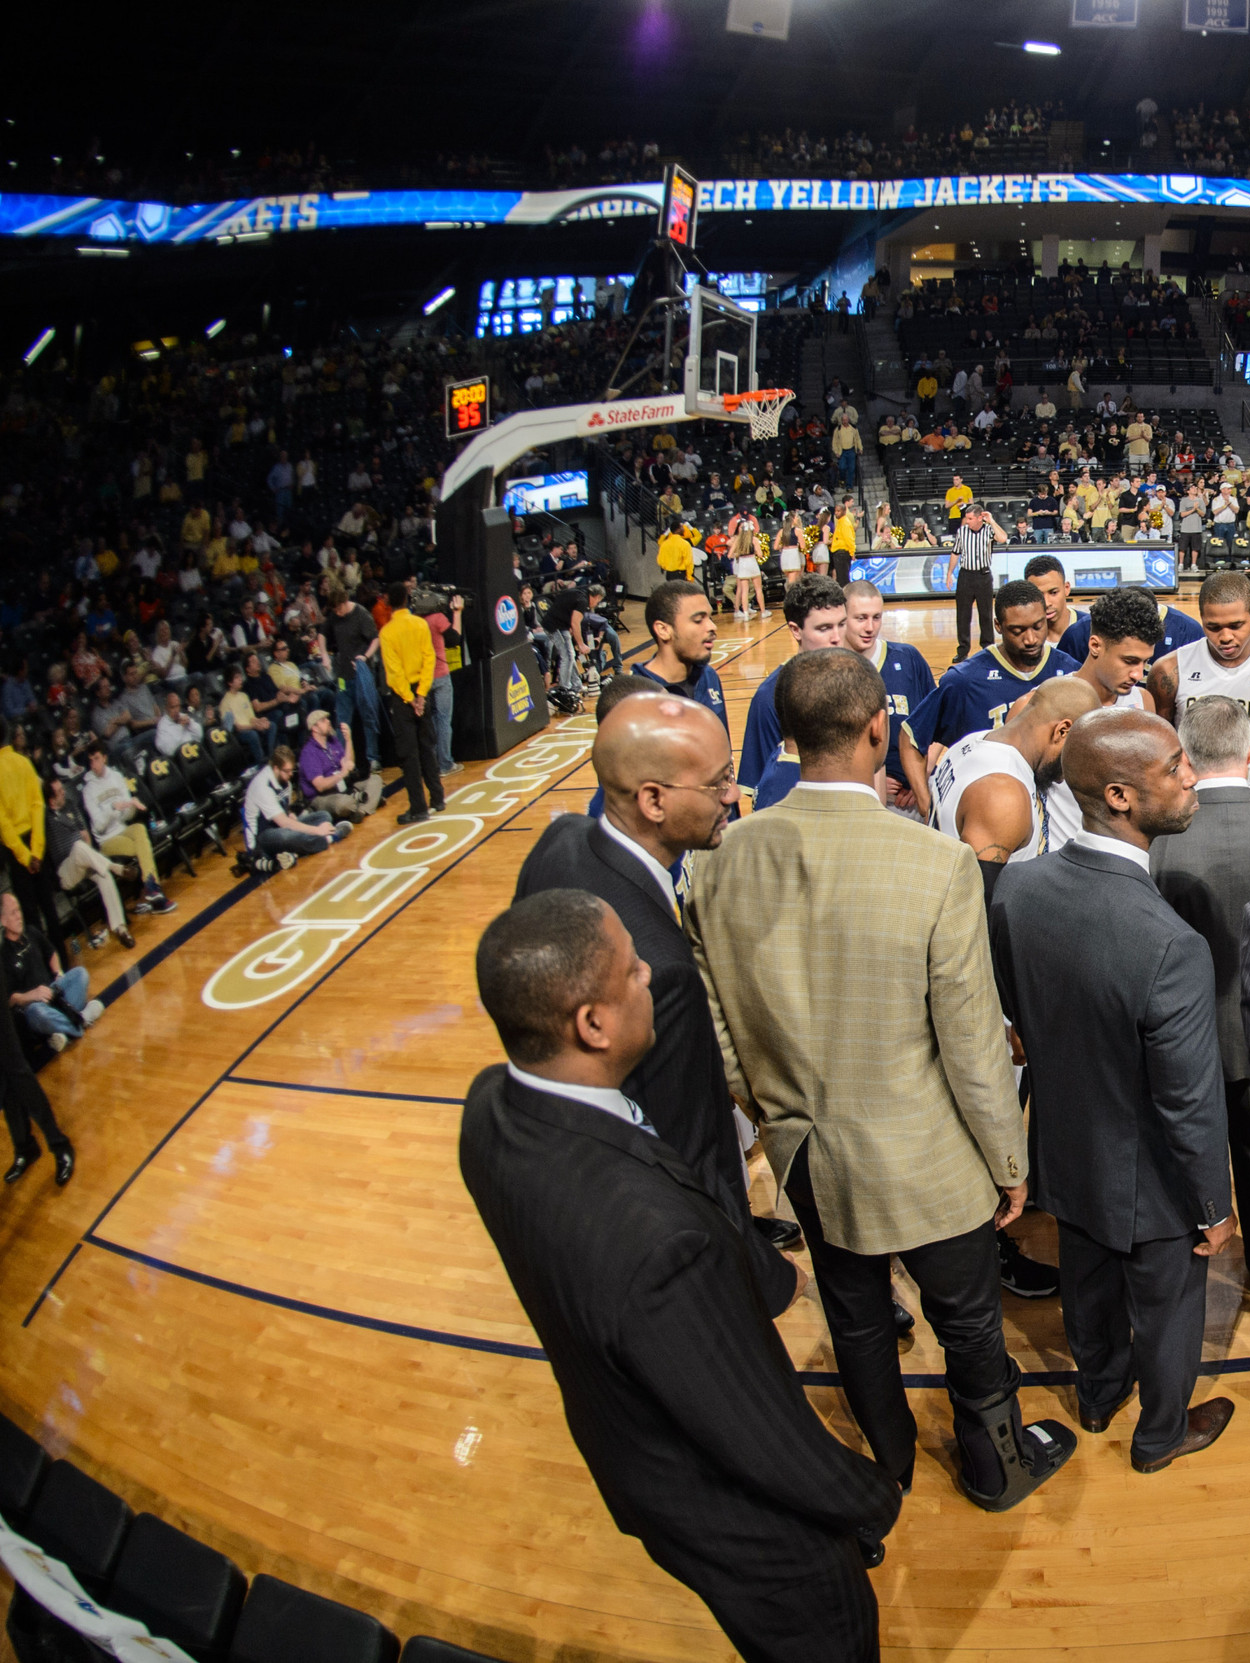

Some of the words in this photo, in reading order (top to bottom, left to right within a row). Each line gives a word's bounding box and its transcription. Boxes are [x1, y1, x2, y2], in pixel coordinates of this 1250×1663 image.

[1205, 18, 1230, 27] ACC
[768, 179, 904, 211] YELLOW
[914, 173, 1075, 207] JACKETS
[451, 384, 486, 409] 20:00
[458, 402, 481, 429] 35
